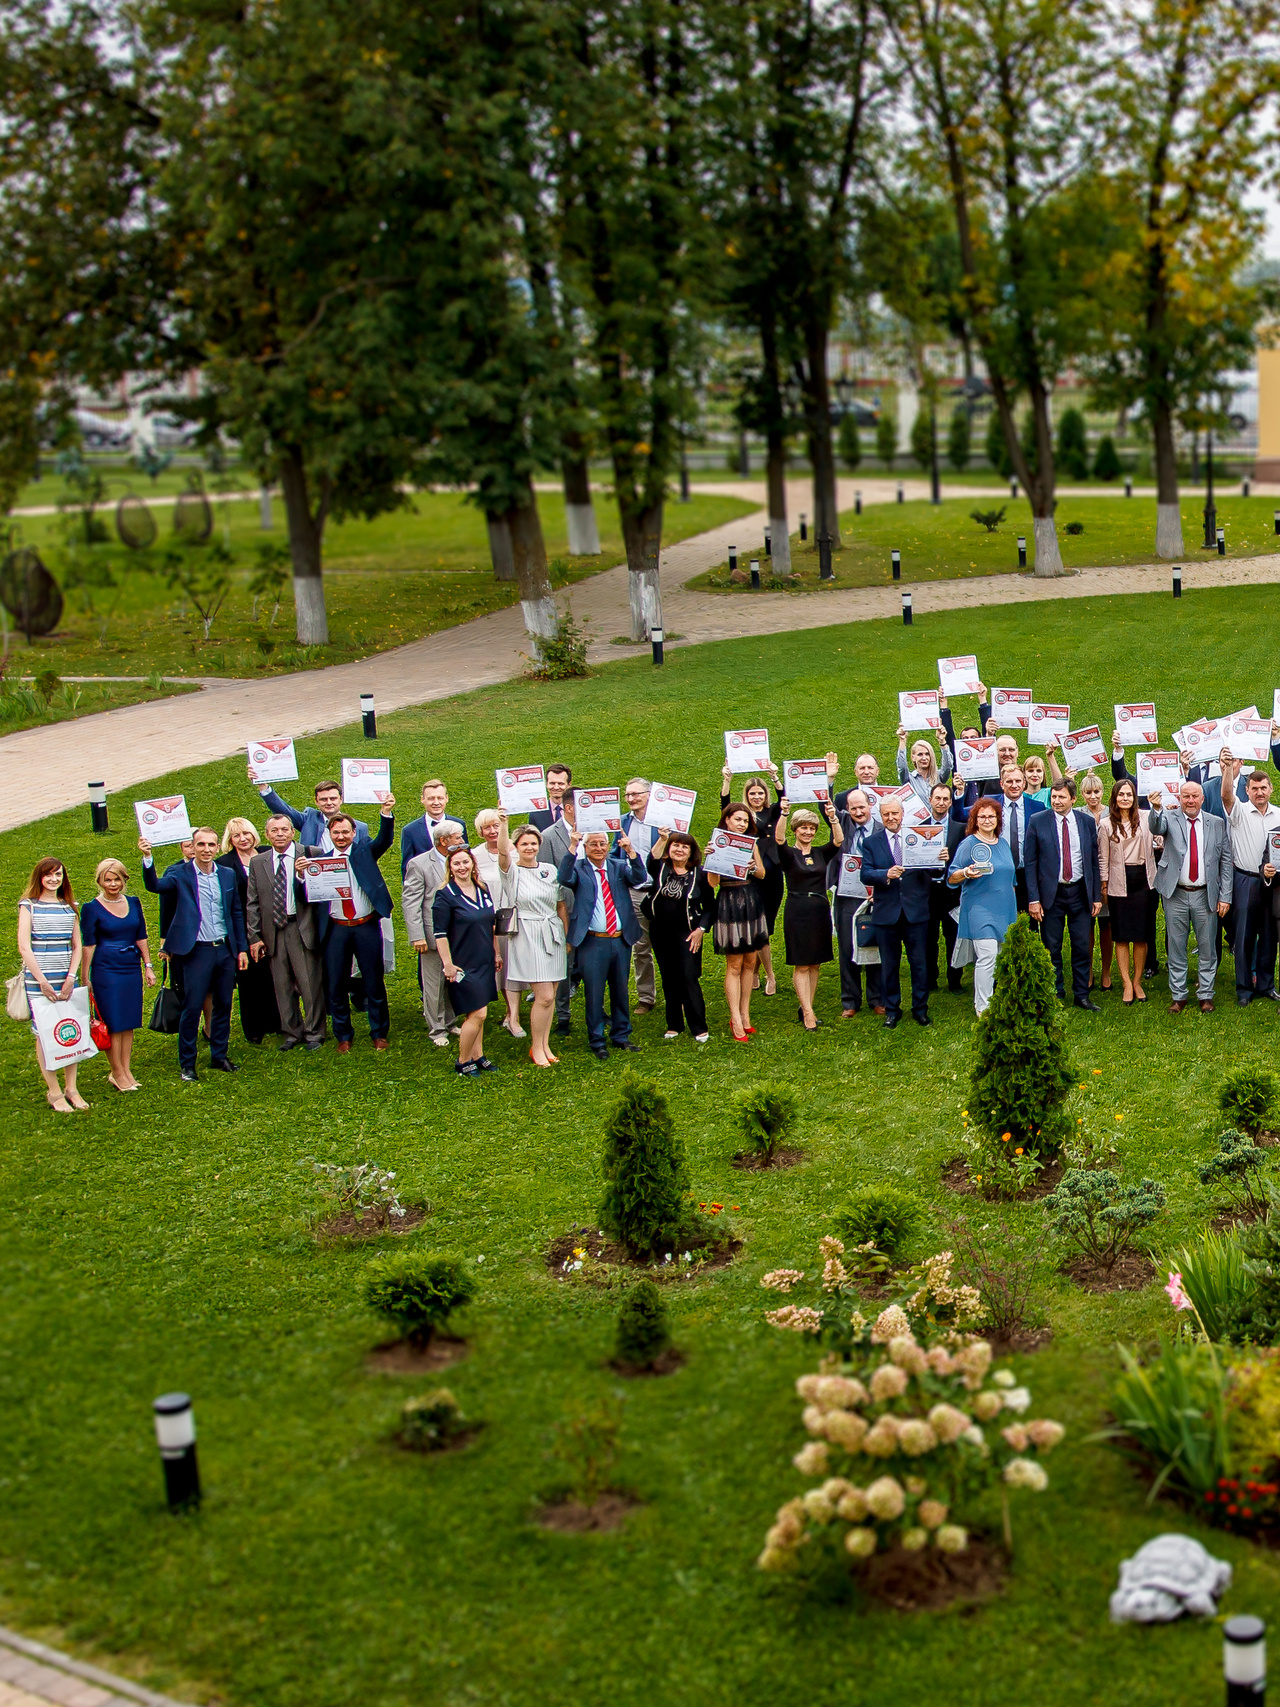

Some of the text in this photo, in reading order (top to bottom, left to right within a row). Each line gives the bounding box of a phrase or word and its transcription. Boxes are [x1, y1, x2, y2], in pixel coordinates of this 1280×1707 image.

[1078, 732, 1098, 741] ДИПЛОМ
[518, 773, 542, 781] ДИПЛОМ
[731, 840, 752, 849] ДИПЛОМ
[323, 863, 346, 871] ДИПЛОМ
